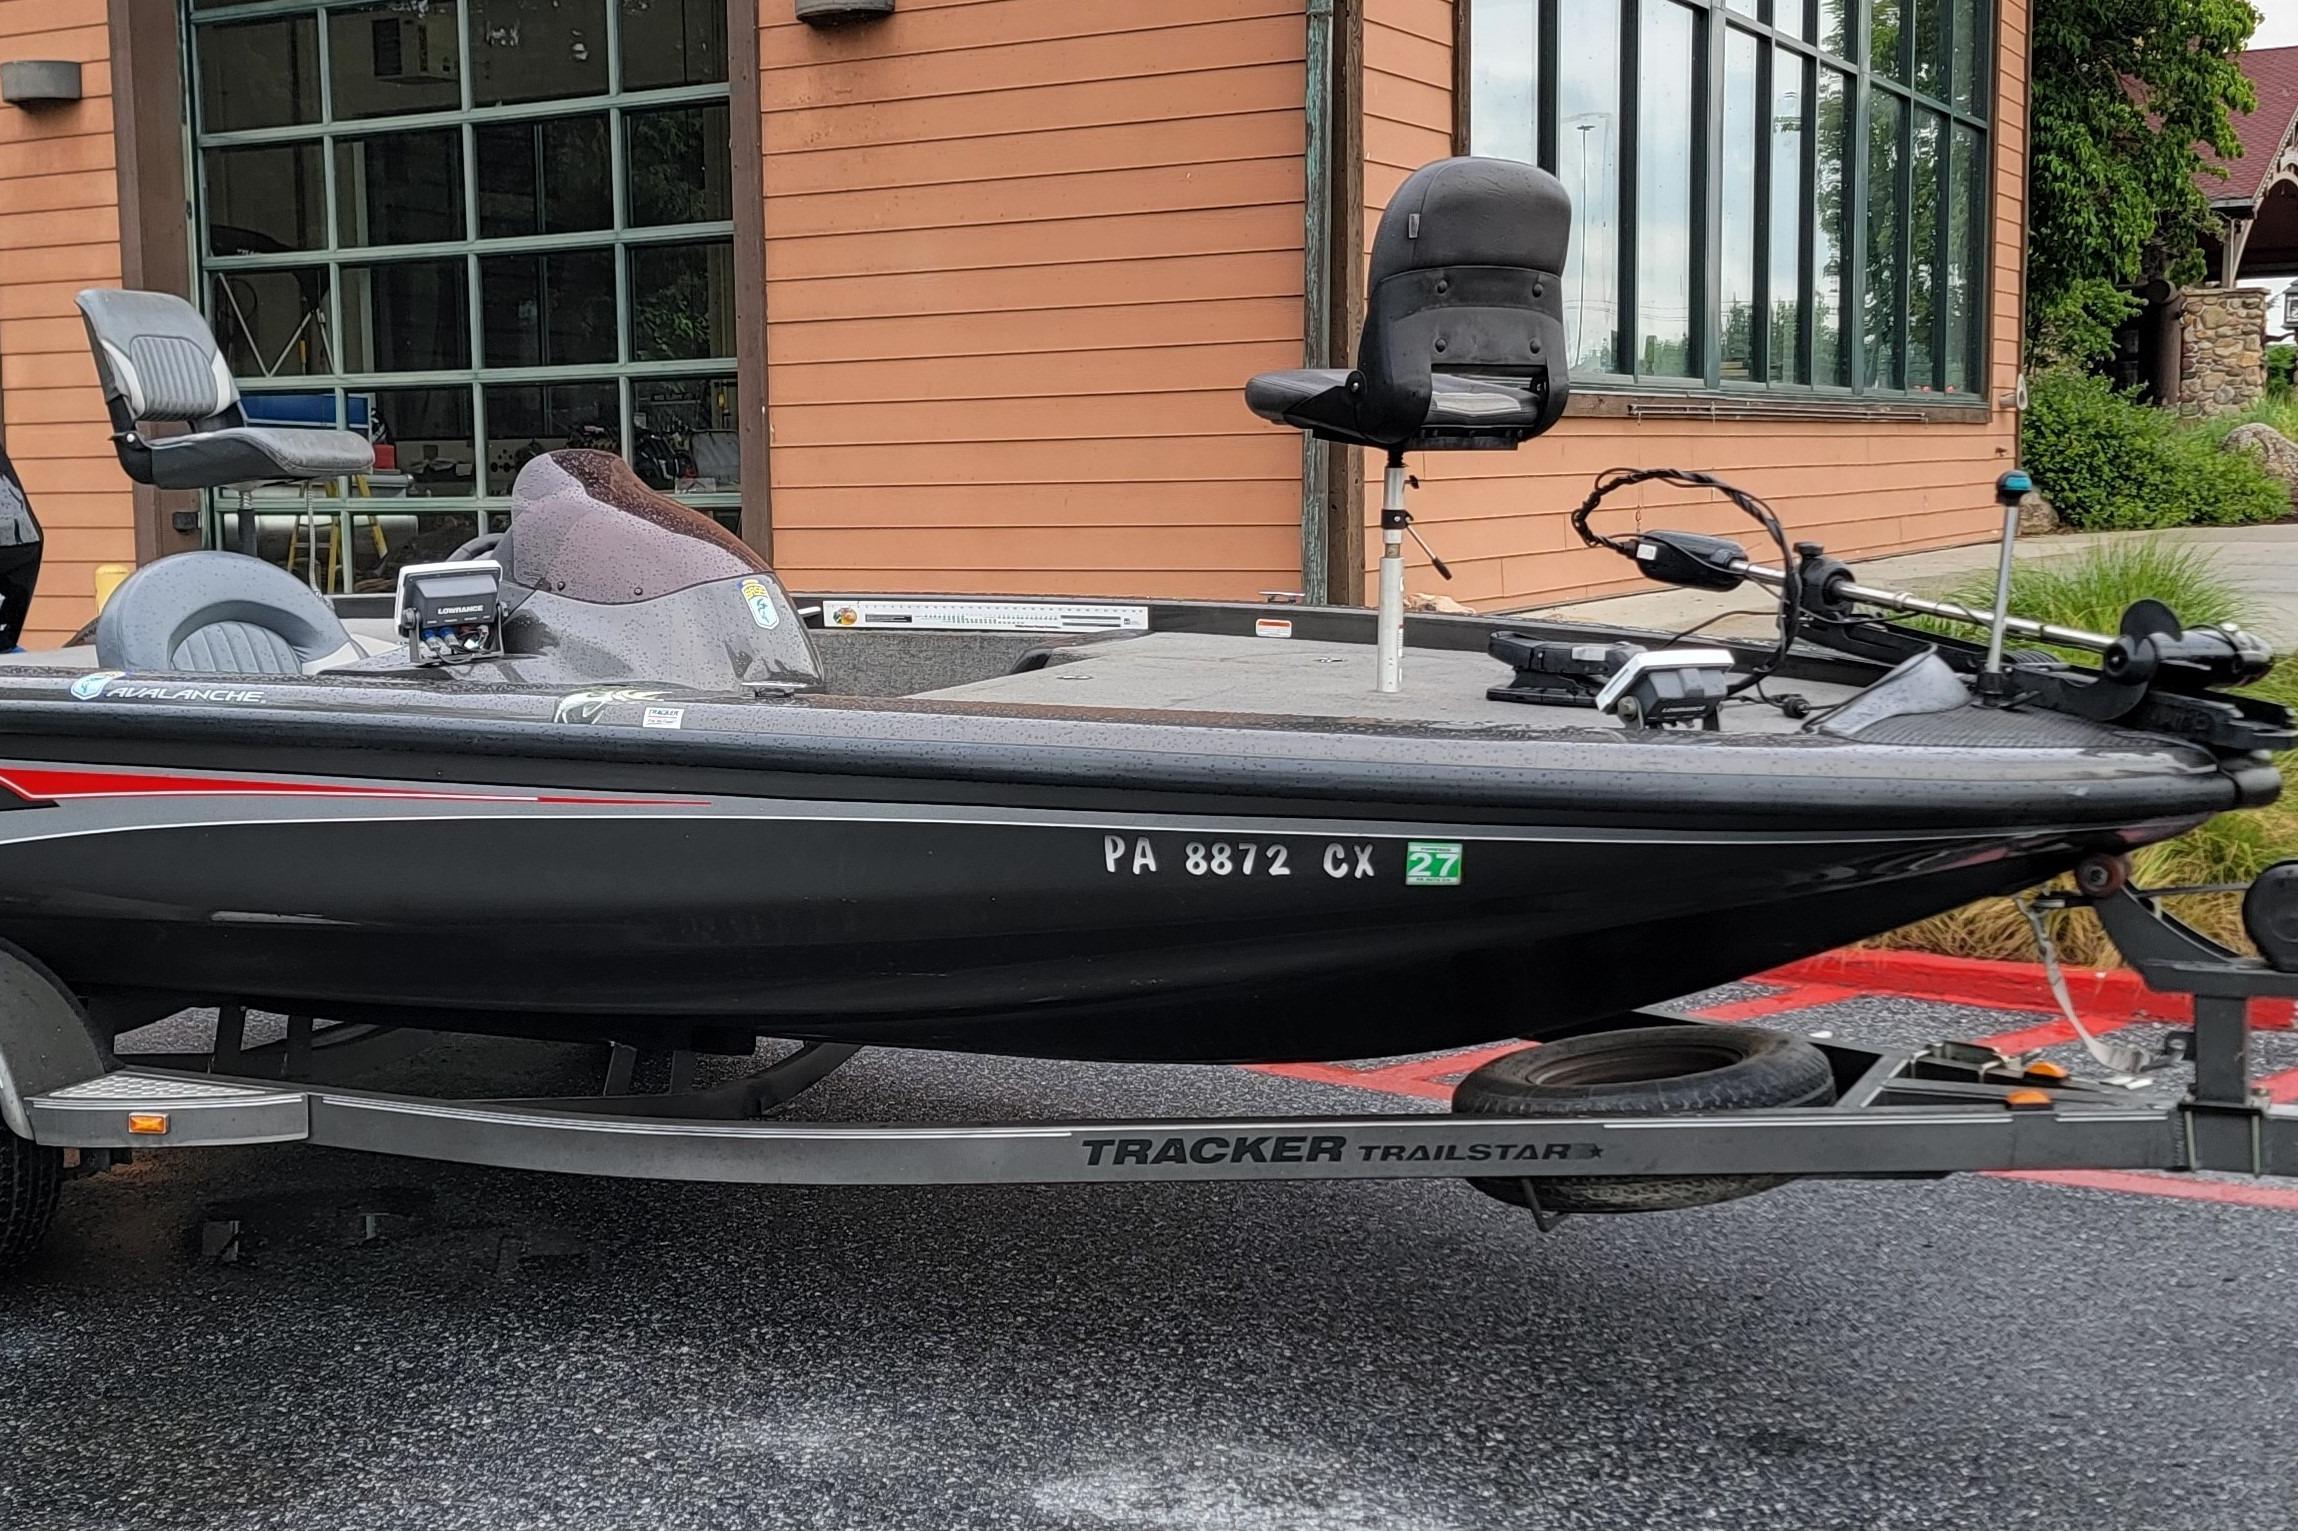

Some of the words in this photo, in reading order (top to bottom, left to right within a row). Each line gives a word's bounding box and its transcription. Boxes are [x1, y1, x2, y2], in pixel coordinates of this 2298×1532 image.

[106, 687, 265, 702] AVALANCHE
[1104, 835, 1157, 875] PA
[1185, 841, 1292, 877] 8872
[1322, 842, 1375, 879] CX
[1407, 852, 1459, 877] 27
[1081, 1136, 1346, 1166] TRACKER
[1357, 1143, 1573, 1162] TRAILSTAR
